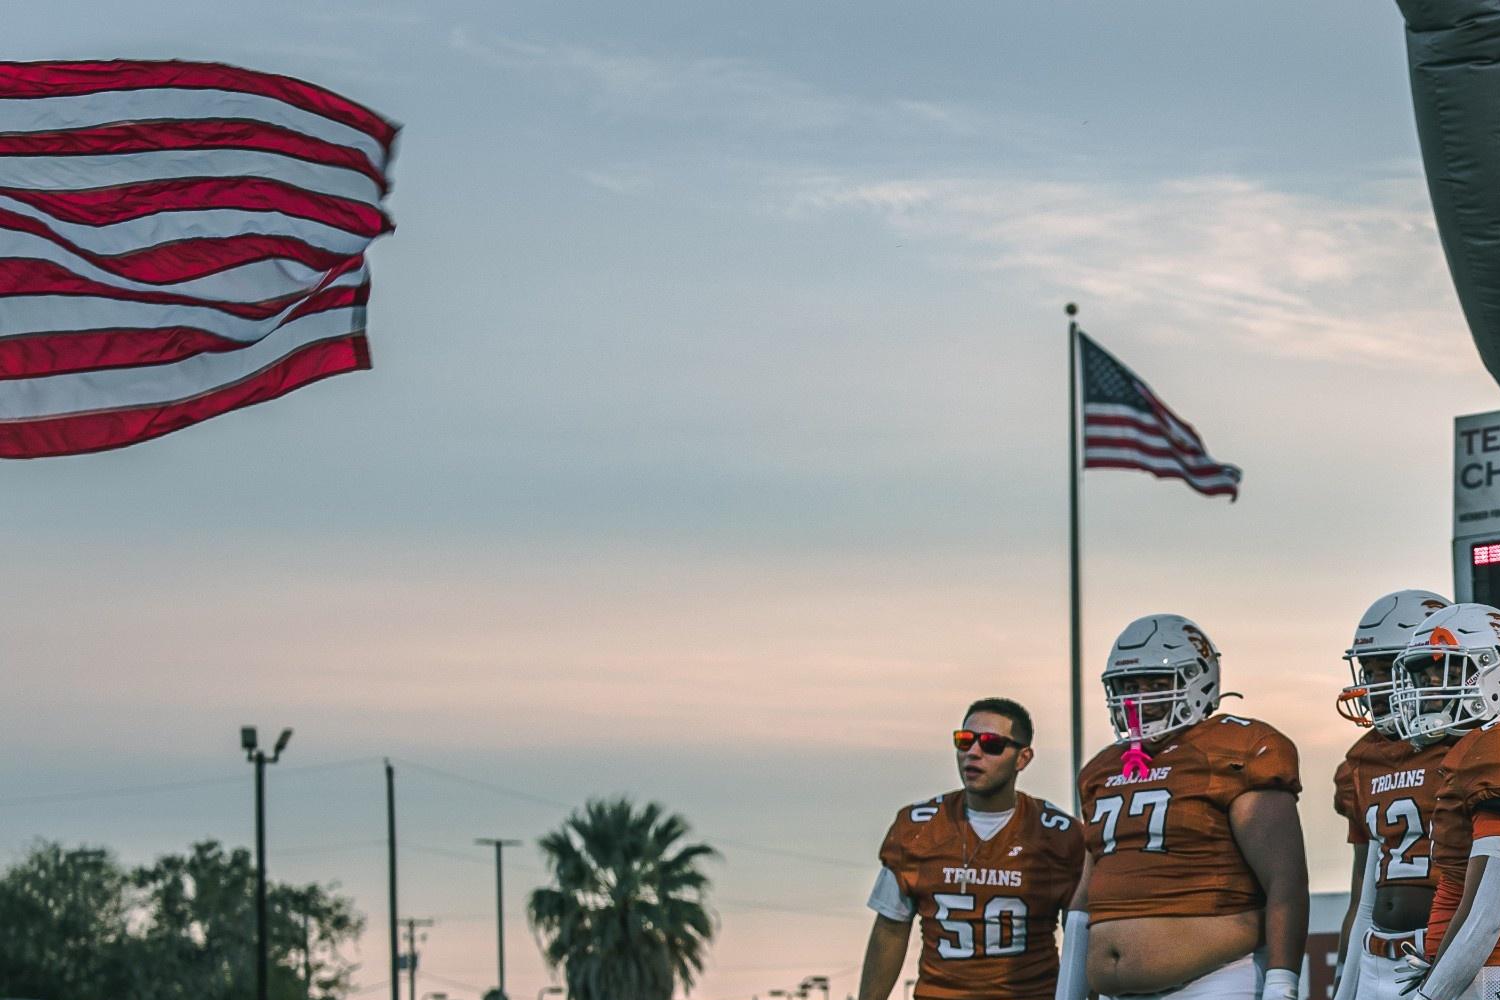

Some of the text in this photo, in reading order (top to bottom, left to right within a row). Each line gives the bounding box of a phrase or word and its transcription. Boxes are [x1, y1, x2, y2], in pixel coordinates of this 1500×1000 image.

[1371, 768, 1425, 795] TROJANS
[1090, 787, 1173, 854] 77
[1365, 796, 1432, 886] 12
[942, 867, 1022, 887] TROJANS
[932, 892, 1029, 960] 50
